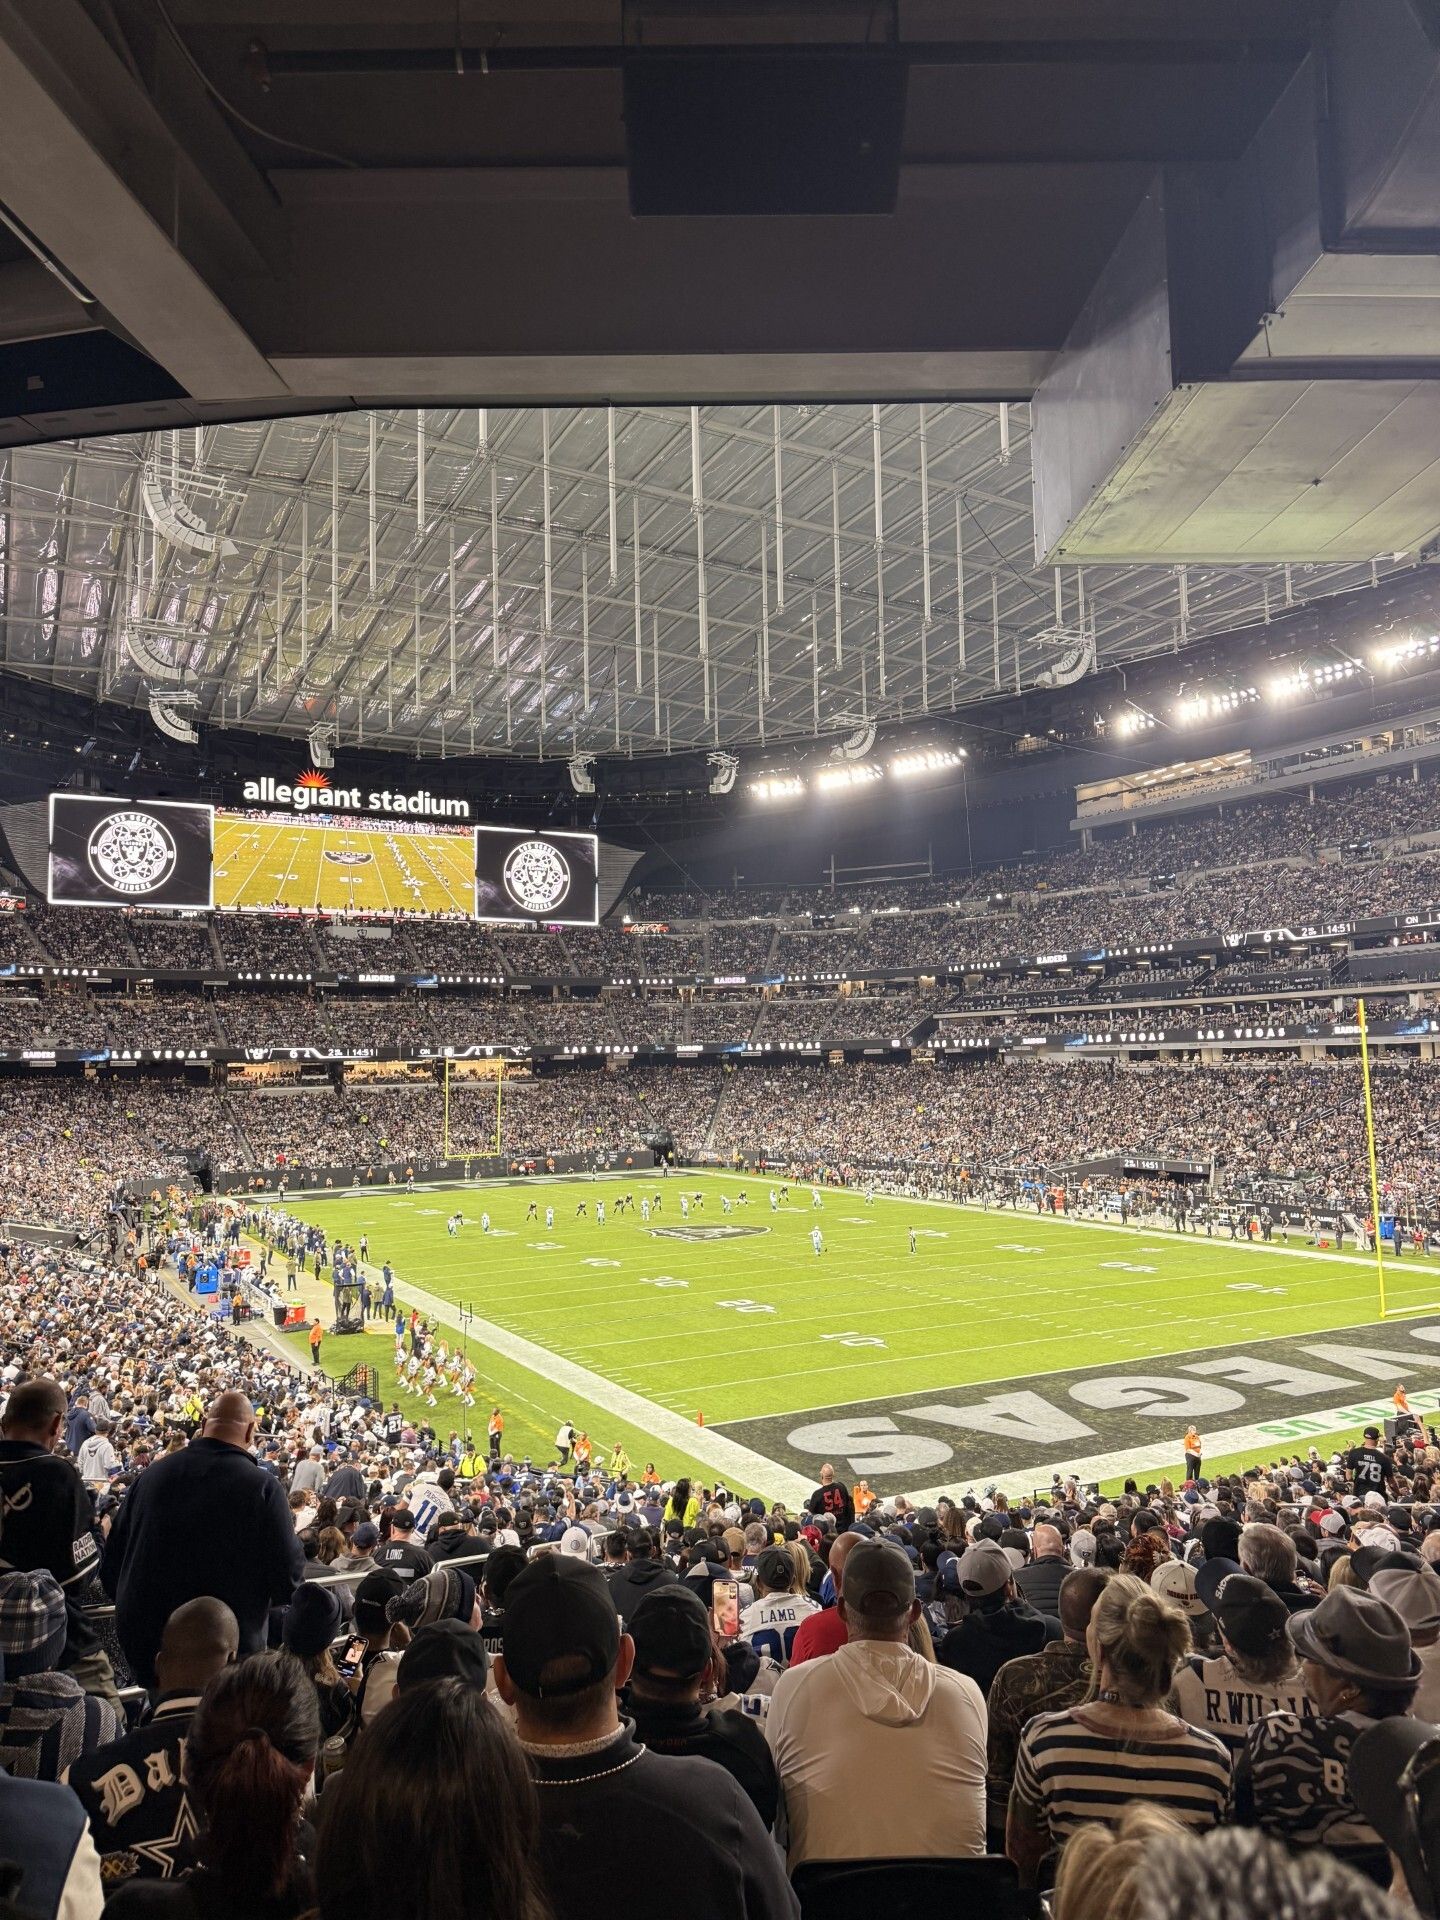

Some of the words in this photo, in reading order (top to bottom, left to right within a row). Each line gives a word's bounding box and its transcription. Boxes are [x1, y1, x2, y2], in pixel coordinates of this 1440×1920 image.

[243, 777, 361, 810] allegiant
[368, 790, 470, 817] stadium
[1406, 916, 1418, 924] ON
[1327, 923, 1351, 934] 14:51
[1136, 944, 1172, 953] VEGAS
[1037, 954, 1067, 964] RAIDERS
[814, 972, 846, 980] VEGAS
[1088, 1034, 1111, 1042] LAS
[1120, 1031, 1164, 1041] VEGAS
[1198, 1030, 1224, 1039] LAS
[1235, 1028, 1285, 1039] VEGAS
[954, 1039, 989, 1047] VEGAS
[112, 1051, 141, 1059] LAS
[153, 1050, 207, 1058] VEGAS
[290, 1049, 298, 1058] 6
[352, 1048, 374, 1056] 14:51
[595, 1046, 638, 1054] VEGAS
[716, 1299, 778, 1314] 20
[820, 1331, 889, 1348] 10
[786, 1344, 1440, 1476] VEGAS
[1358, 1461, 1382, 1482] 78
[424, 1490, 446, 1510] PARSONS
[824, 1488, 844, 1510] 54
[414, 1500, 438, 1535] 11
[386, 1549, 403, 1560] LONG
[760, 1608, 796, 1624] LAMB
